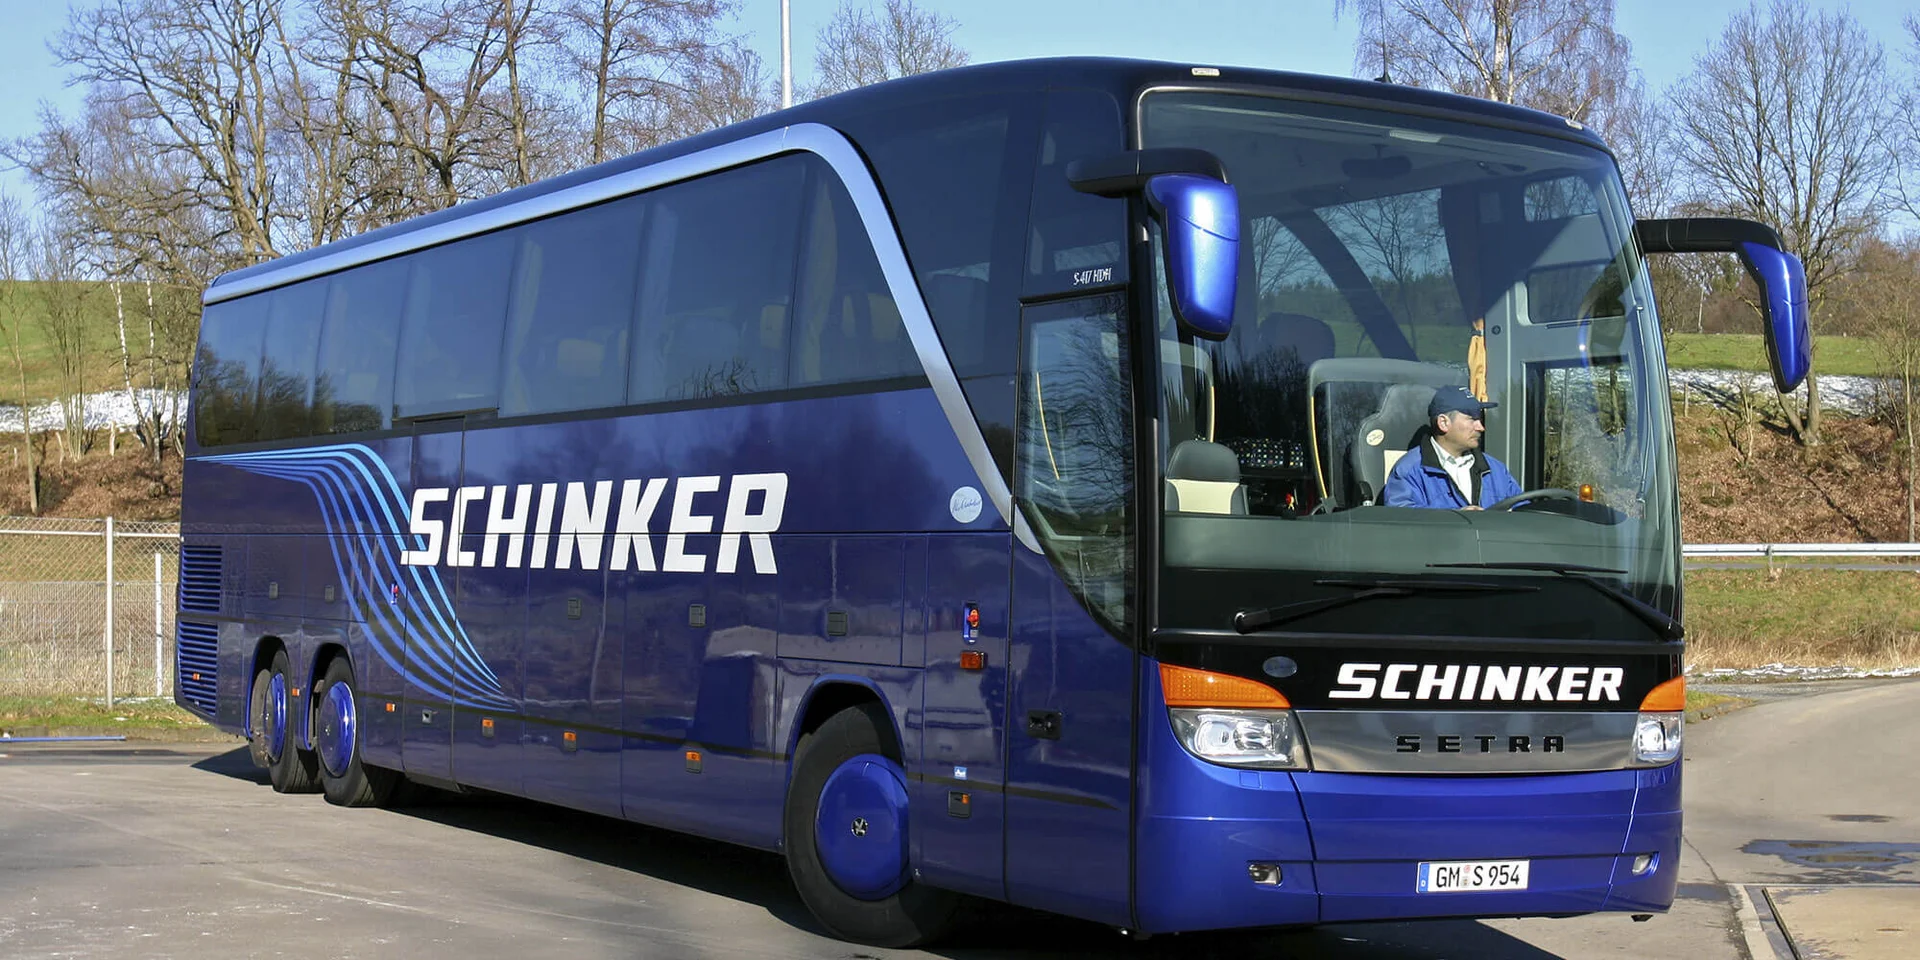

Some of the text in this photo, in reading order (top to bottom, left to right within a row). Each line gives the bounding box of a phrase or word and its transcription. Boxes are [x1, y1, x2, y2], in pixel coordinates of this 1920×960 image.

[400, 472, 788, 574] SCHINKER
[1328, 663, 1624, 701] SCHINKER
[1396, 735, 1565, 753] SETRA
[1436, 864, 1520, 888] GM S 954
